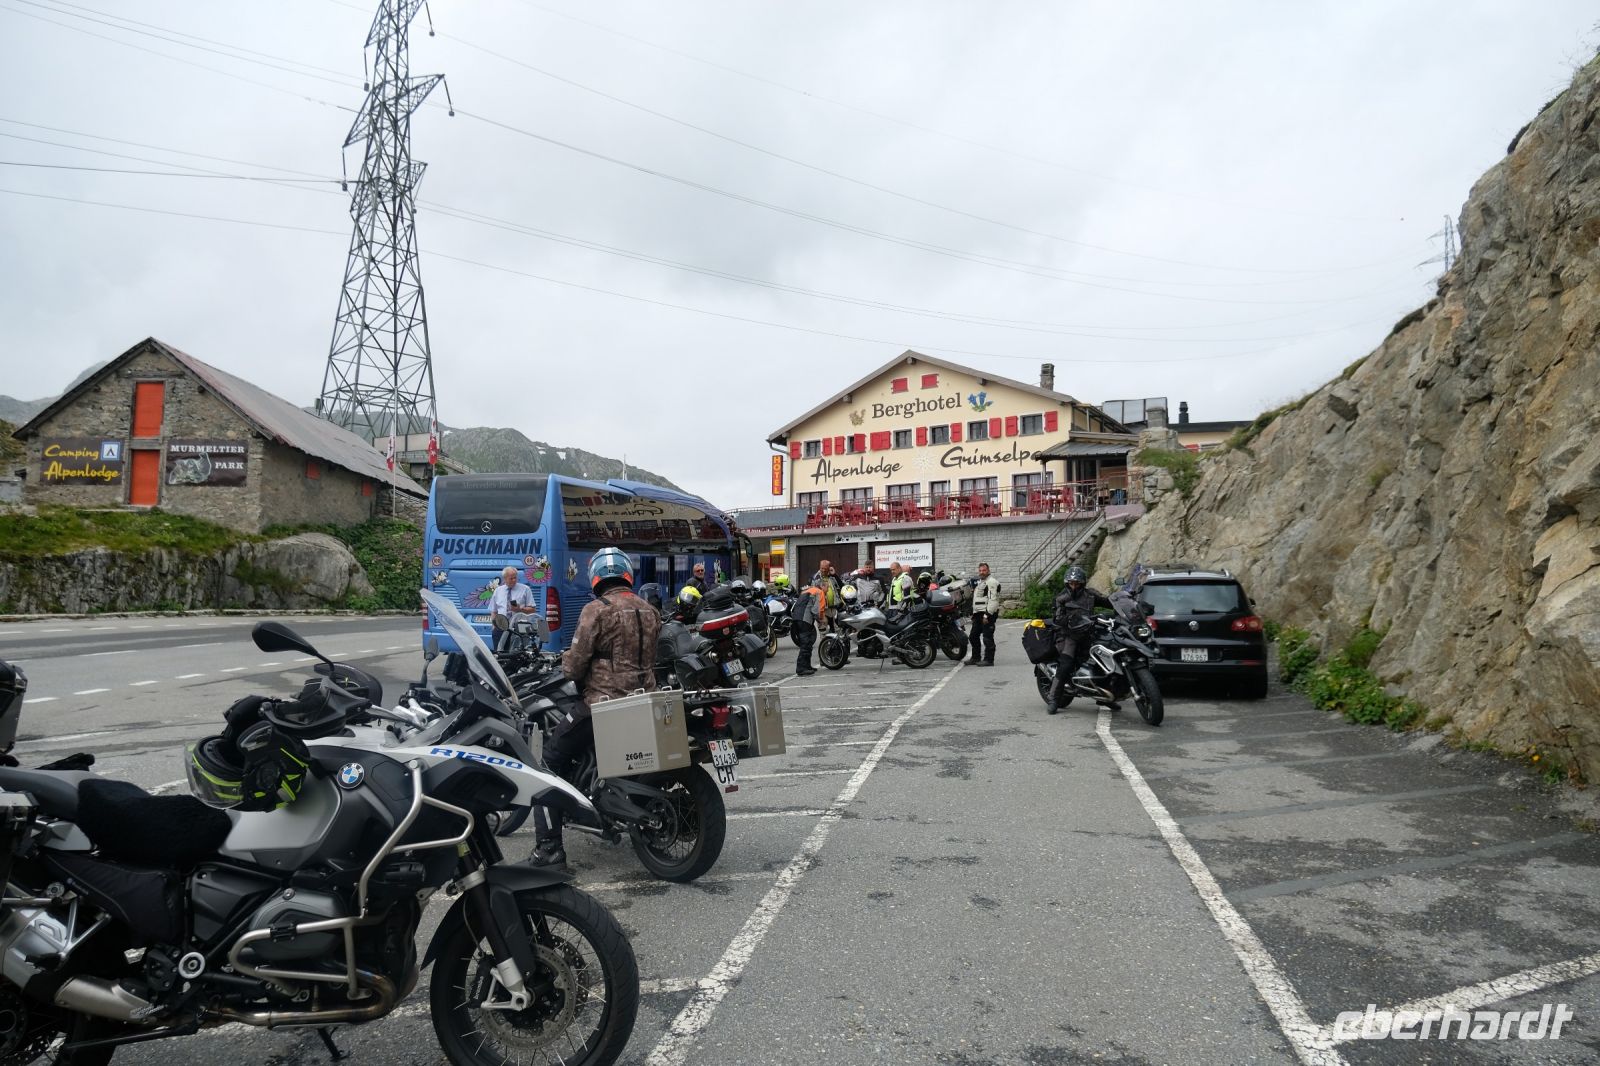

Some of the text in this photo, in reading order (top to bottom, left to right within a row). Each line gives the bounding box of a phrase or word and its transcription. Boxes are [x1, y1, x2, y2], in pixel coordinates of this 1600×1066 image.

[872, 392, 962, 419] Berghotel
[44, 444, 99, 460] Camping
[170, 444, 245, 453] MURMELTIER
[43, 461, 120, 482] Alpenlodge
[215, 461, 244, 470] PARK
[810, 456, 903, 485] Alpenlodge
[773, 455, 781, 495] HOTEL
[432, 538, 542, 555] PUSCHMANN
[716, 740, 728, 751] TG
[430, 747, 523, 770] R1200
[625, 752, 643, 761] ZEGA
[713, 753, 738, 766] 31438
[716, 766, 735, 784] CH
